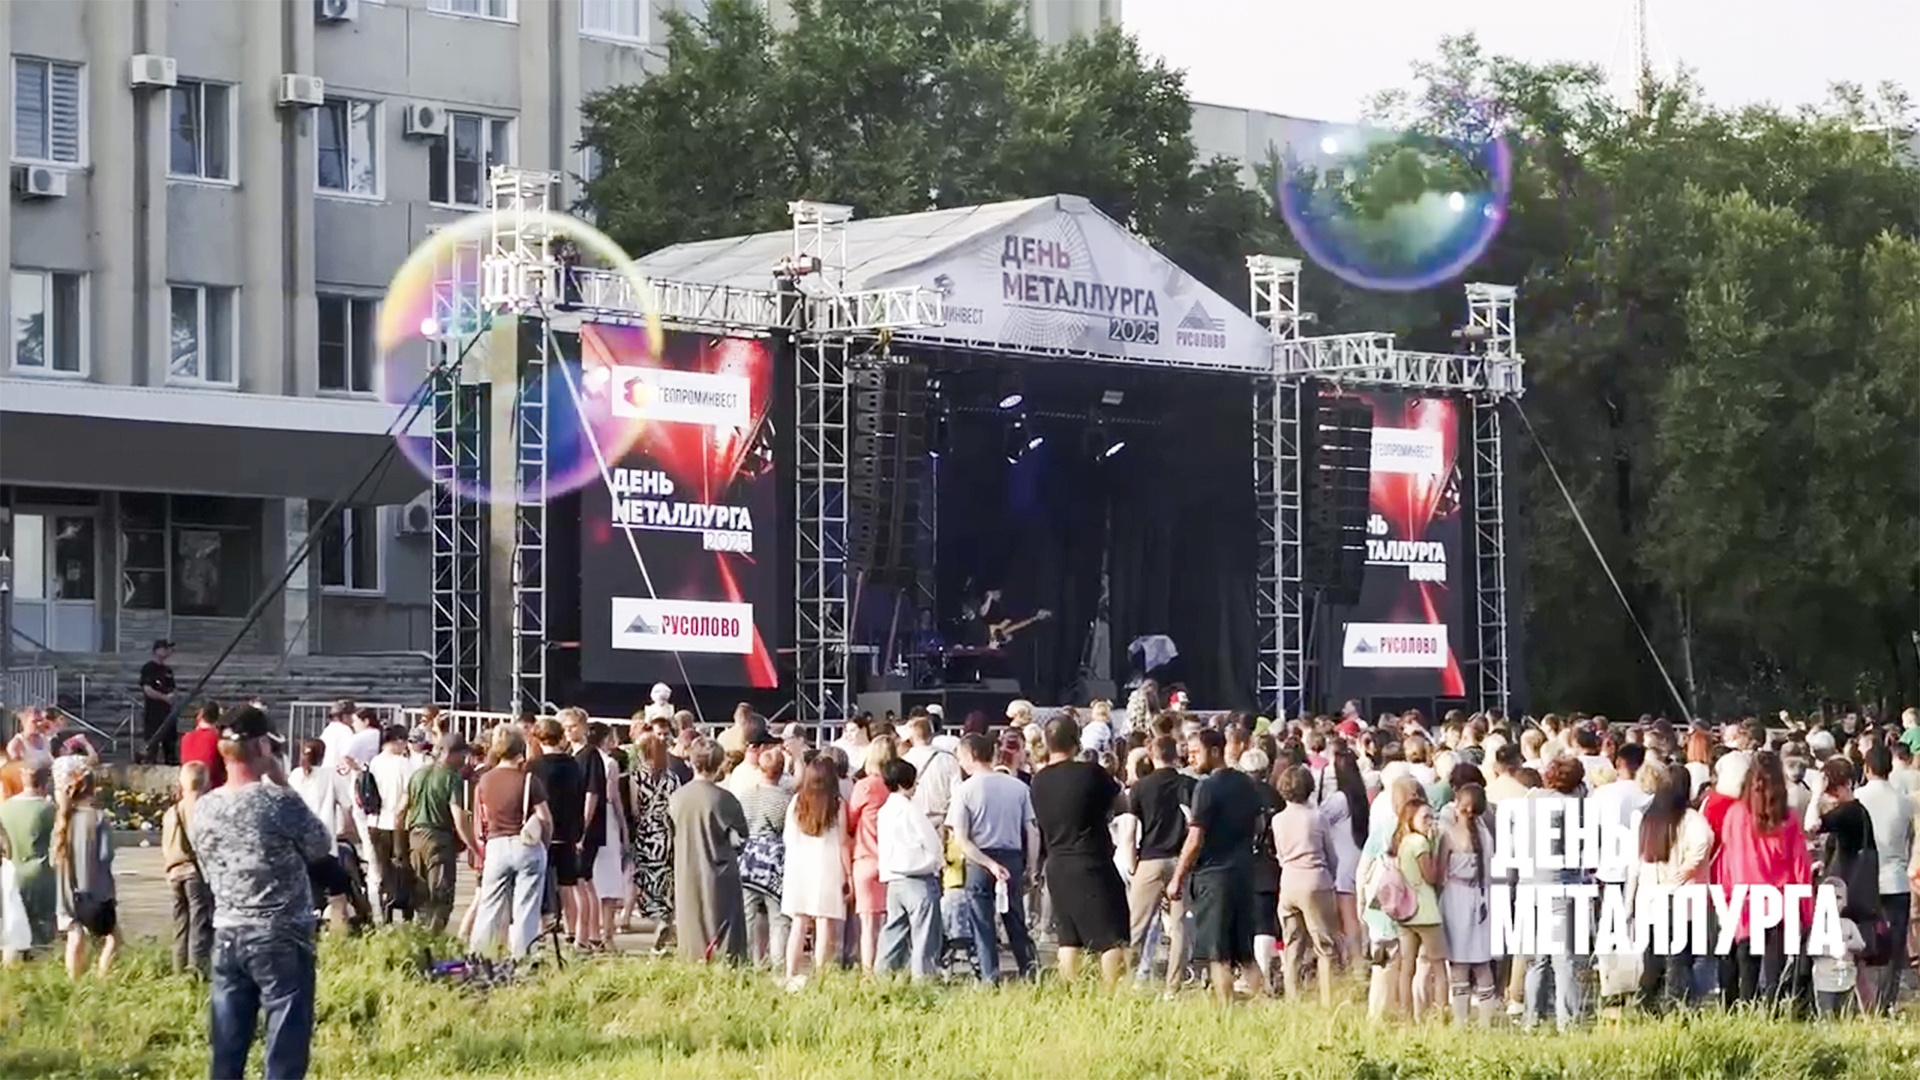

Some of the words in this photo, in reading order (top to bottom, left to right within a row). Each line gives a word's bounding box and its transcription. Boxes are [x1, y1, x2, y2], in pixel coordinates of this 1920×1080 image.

[1001, 235, 1071, 269] ДЕНЬ
[1002, 271, 1158, 317] МЕТАЛЛУРГА
[1110, 318, 1158, 344] 2025
[1176, 331, 1226, 349] РУСОЛОВО
[659, 387, 737, 408] ГЕОПРОМИНВЕСТ
[613, 468, 674, 496] ДЕНЬ
[612, 499, 752, 529] МЕТАЛЛУРГА
[1366, 514, 1388, 535] НЬ
[706, 531, 751, 551] 2025
[1365, 540, 1446, 562] ТАЛЛУРГА
[662, 615, 740, 637] РУСОЛОВО
[1381, 637, 1436, 654] РУСОЛОВО
